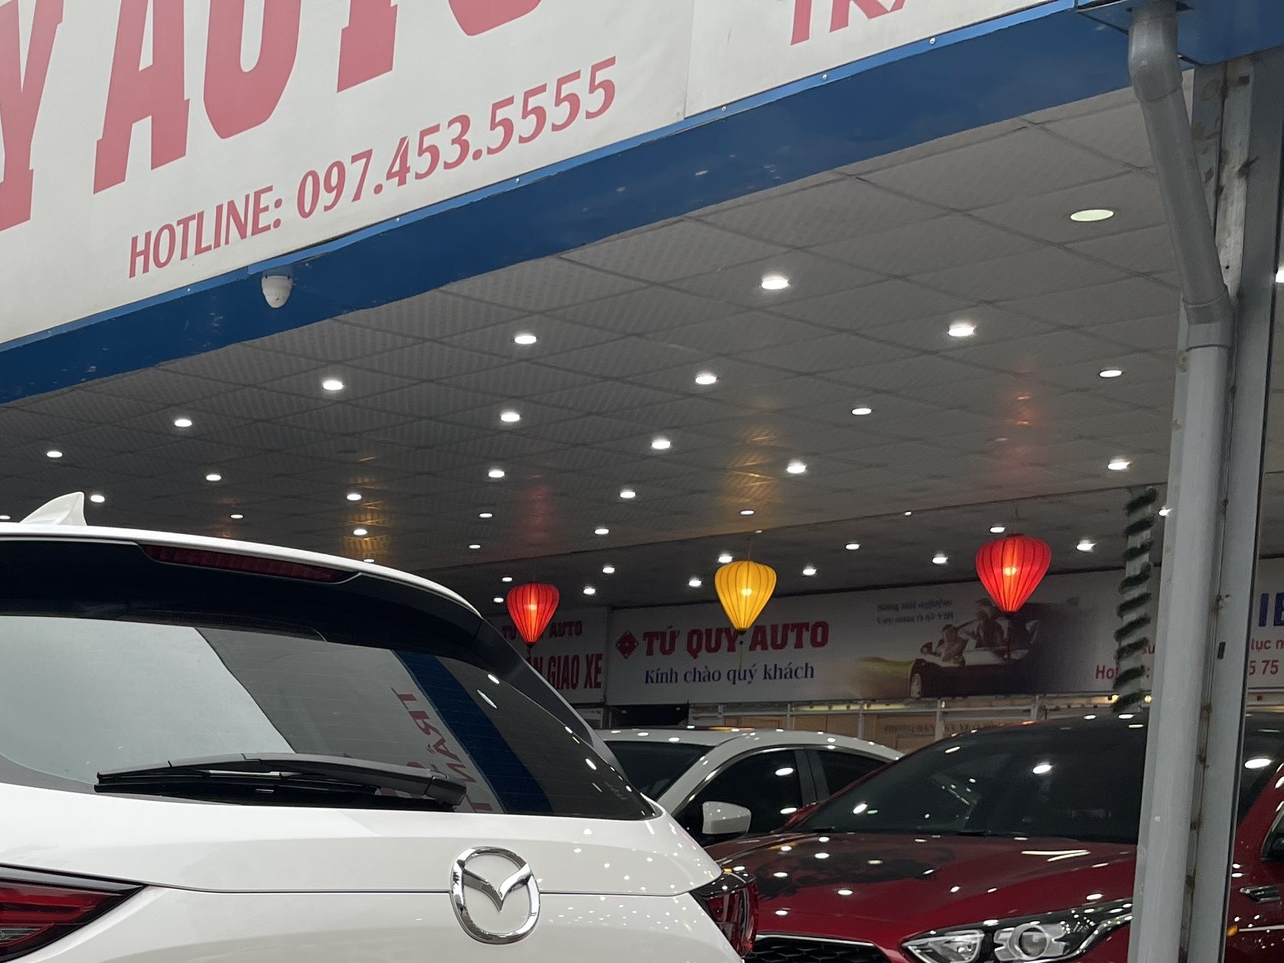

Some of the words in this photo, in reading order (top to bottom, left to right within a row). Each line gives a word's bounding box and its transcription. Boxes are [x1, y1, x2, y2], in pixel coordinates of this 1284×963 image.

[128, 185, 282, 278] HOTLINE:
[296, 56, 616, 219] 097.453.5555
[548, 621, 583, 638] AUTO
[749, 620, 829, 651] AUTO
[546, 654, 580, 690] GIAO
[583, 653, 603, 689] XE
[644, 667, 678, 685] Kính
[683, 665, 721, 683] chào
[727, 663, 757, 685] quý
[763, 662, 815, 681] khách
